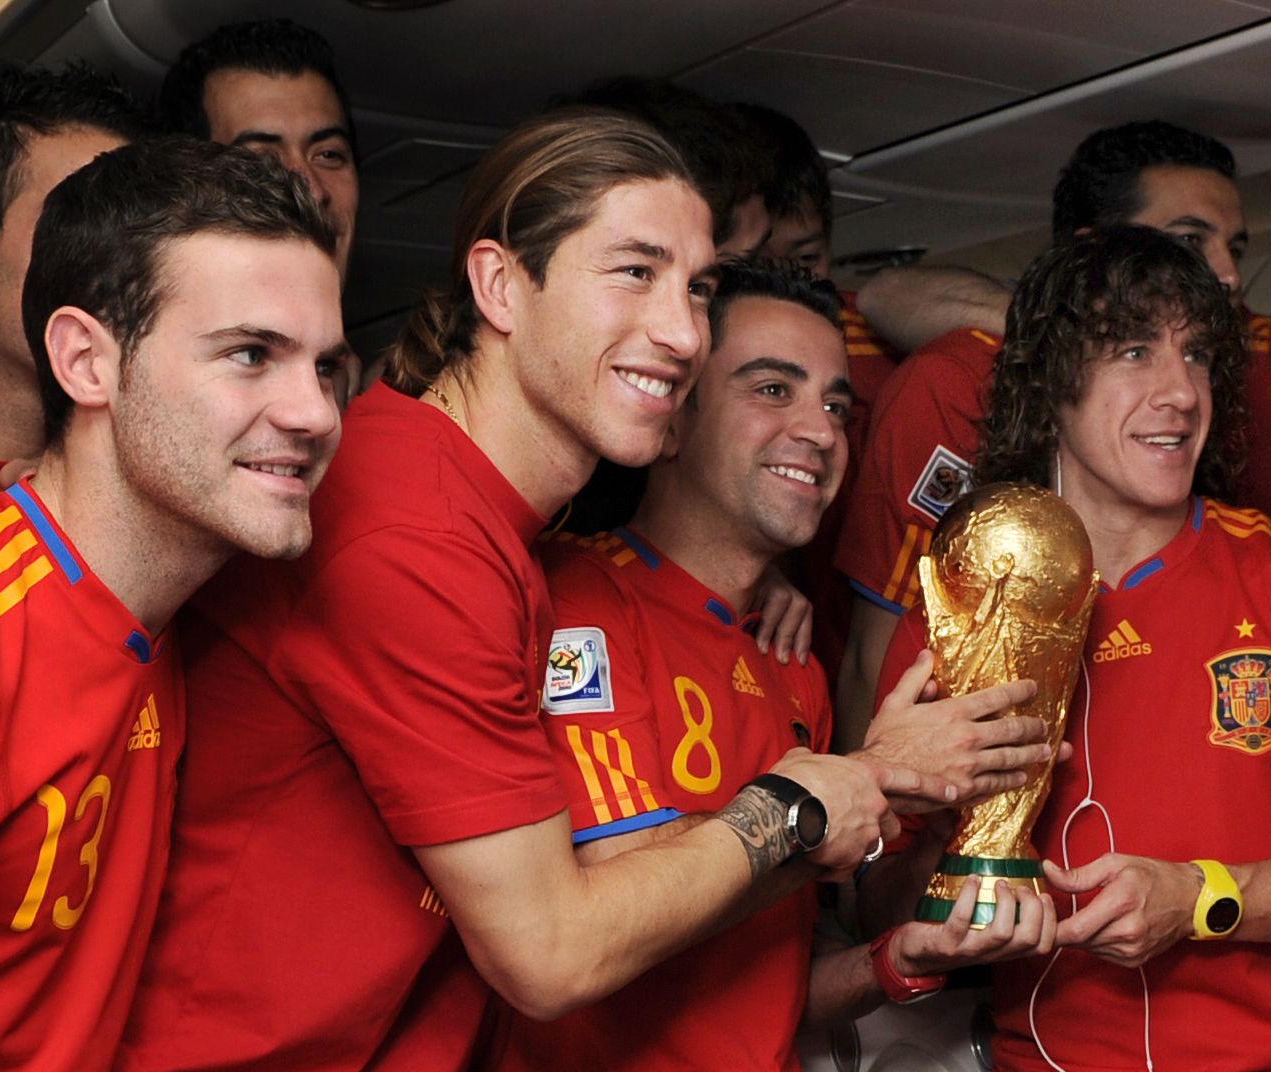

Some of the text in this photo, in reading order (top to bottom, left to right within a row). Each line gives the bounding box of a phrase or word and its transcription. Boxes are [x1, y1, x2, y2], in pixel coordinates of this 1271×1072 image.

[1093, 642, 1153, 664] adidas
[672, 675, 722, 794] 8
[10, 774, 112, 932] 13
